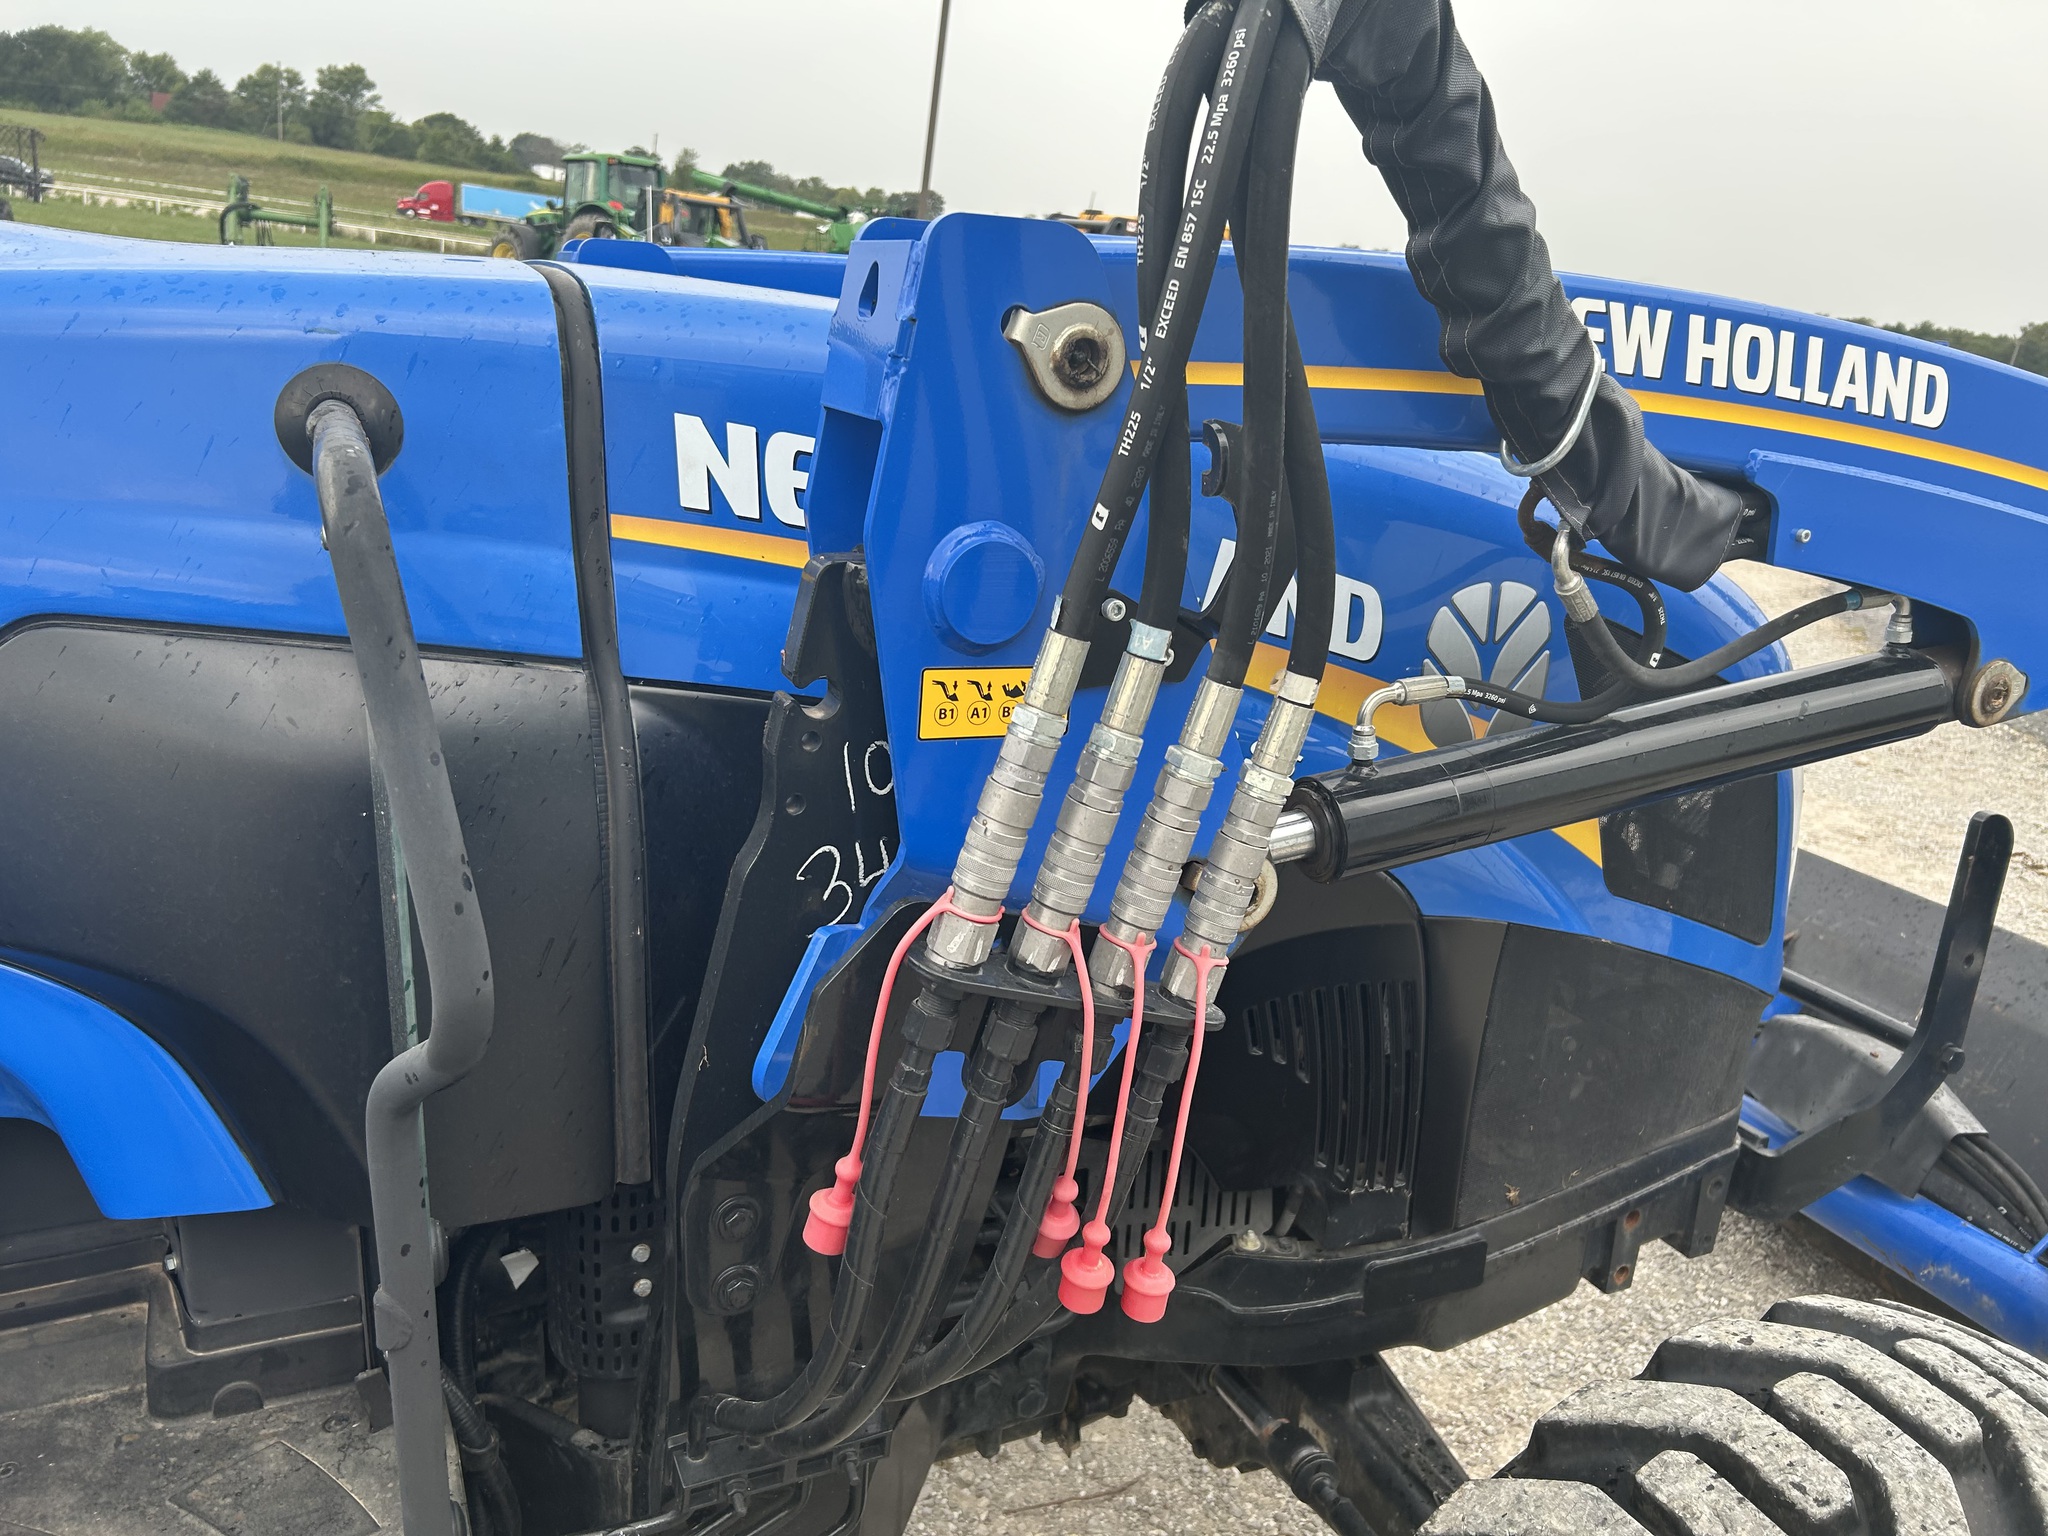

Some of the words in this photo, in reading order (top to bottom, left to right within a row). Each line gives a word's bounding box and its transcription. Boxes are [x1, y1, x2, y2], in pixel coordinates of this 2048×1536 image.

[1118, 410, 1142, 457] TH225
[1155, 279, 1180, 339] EXCEED
[1175, 246, 1189, 269] EN
[1182, 213, 1198, 244] 857
[1191, 179, 1207, 207] 1SC
[1202, 130, 1219, 164] 22.5
[1211, 93, 1229, 127] Mpa
[1221, 51, 1240, 87] 3260
[1233, 27, 1247, 48] psi
[1685, 313, 1949, 430] HOLLAND
[939, 708, 955, 720] B1
[970, 707, 988, 719] A1
